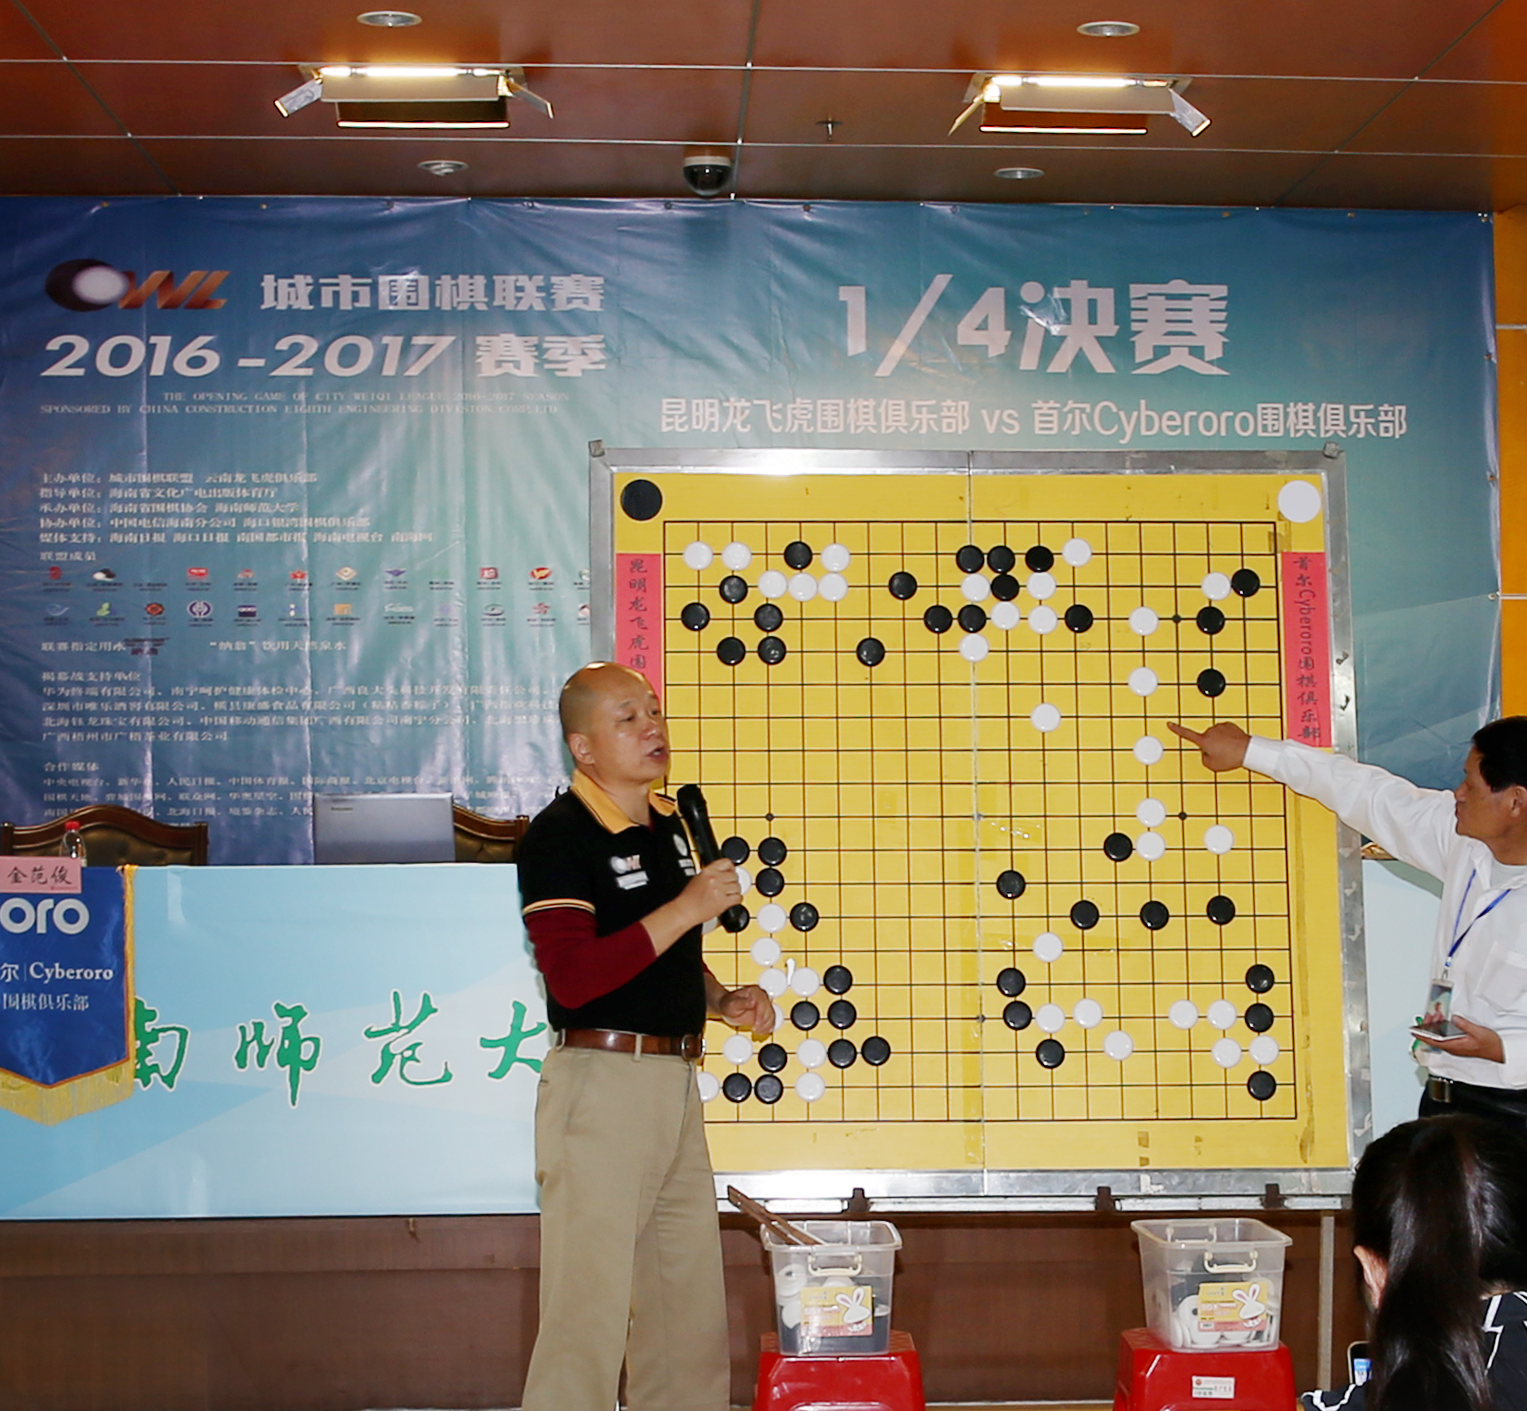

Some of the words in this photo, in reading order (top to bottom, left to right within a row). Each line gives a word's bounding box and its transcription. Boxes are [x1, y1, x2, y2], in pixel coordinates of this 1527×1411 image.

[260, 273, 606, 312] 城市围棋联赛
[838, 273, 1230, 377] 1/4决赛
[475, 333, 607, 378] 赛季
[40, 404, 111, 415] SPONSORED
[117, 404, 132, 415] BY
[138, 404, 179, 415] CHINA
[164, 391, 187, 402] THE
[192, 391, 248, 402] OPENING
[254, 391, 286, 402] GAME
[660, 398, 971, 437] 昆明龙飞虎围棋俱乐部
[983, 409, 1020, 435] vs
[1031, 400, 1409, 444] 首尔Cyberoro围棋俱乐部
[1293, 556, 1321, 739] 首尔Cyberoro围棋俱乐部
[0, 897, 90, 935] oro
[29, 961, 114, 984] Cyberoro
[2, 993, 90, 1011] 围棋俱乐部
